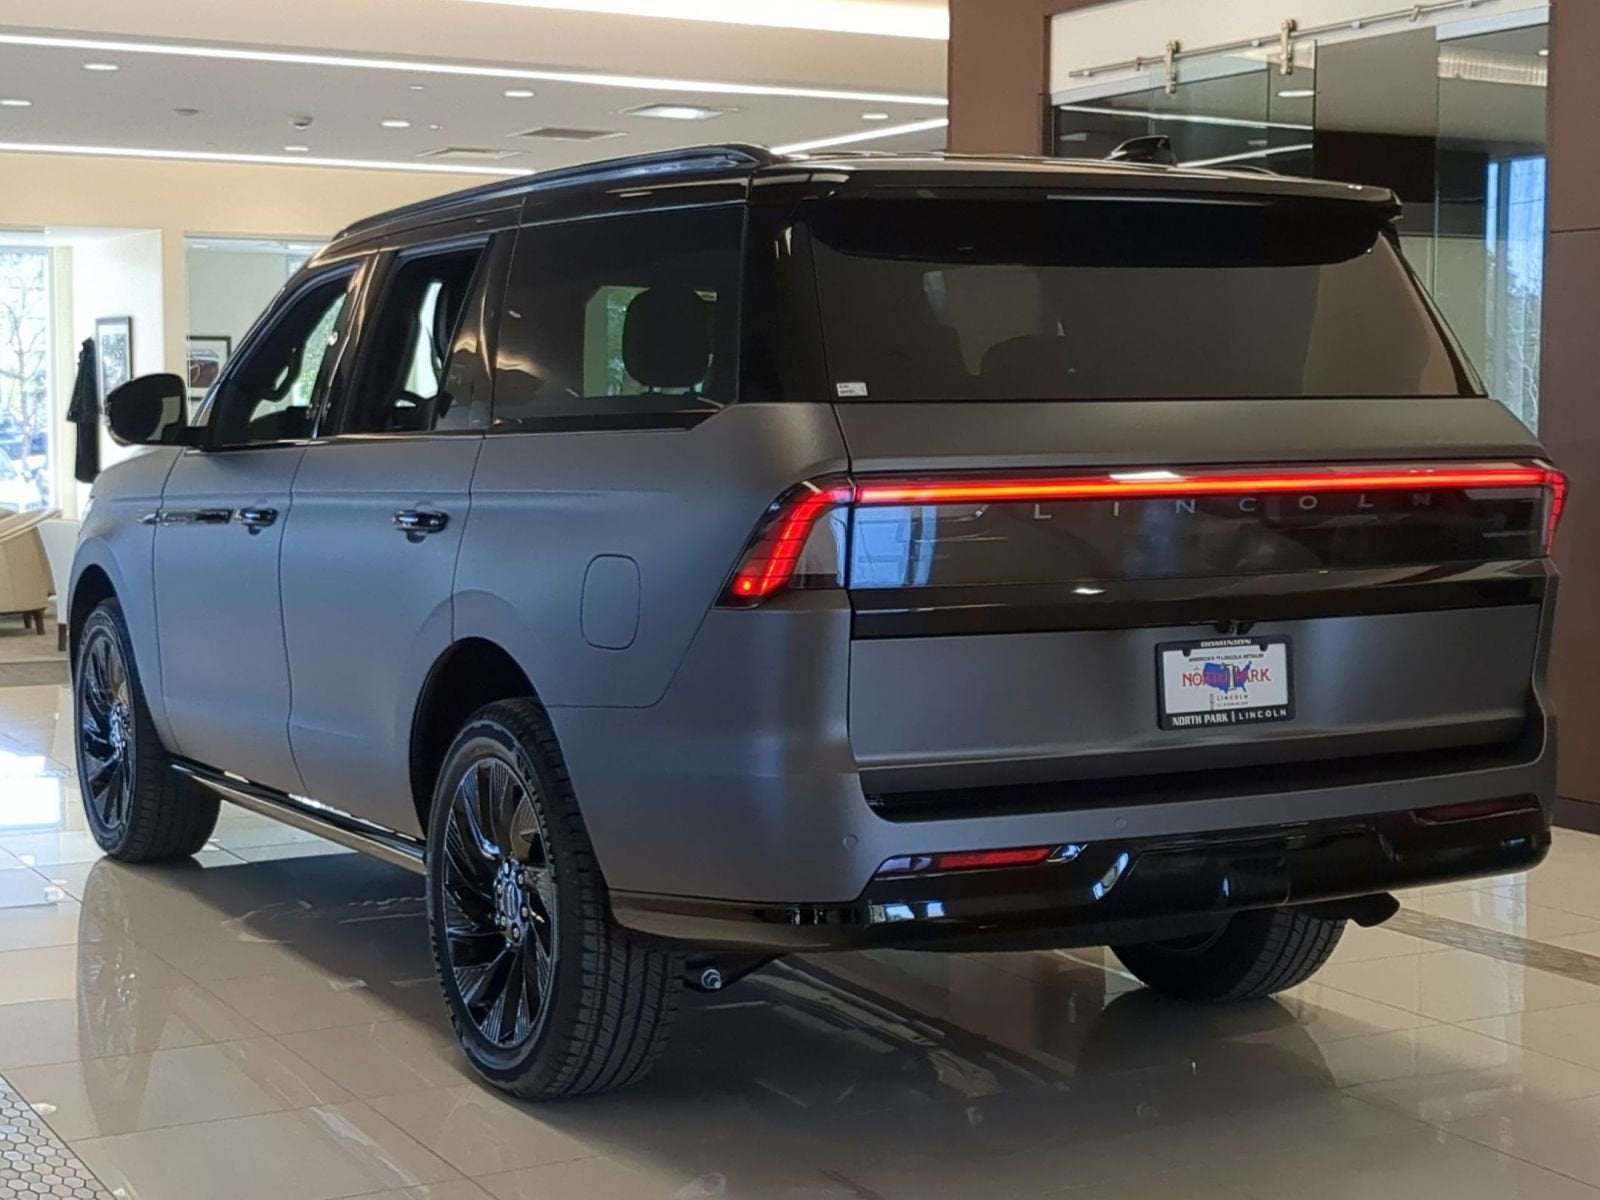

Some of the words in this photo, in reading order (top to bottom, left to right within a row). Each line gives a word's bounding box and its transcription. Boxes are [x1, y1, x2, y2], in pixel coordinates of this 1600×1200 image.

[1033, 493, 1432, 520] LINCOLN
[1201, 638, 1251, 647] DOMINION
[1172, 715, 1202, 726] NORTH
[1204, 712, 1228, 723] PARK
[1239, 708, 1287, 720] LINCOLN
